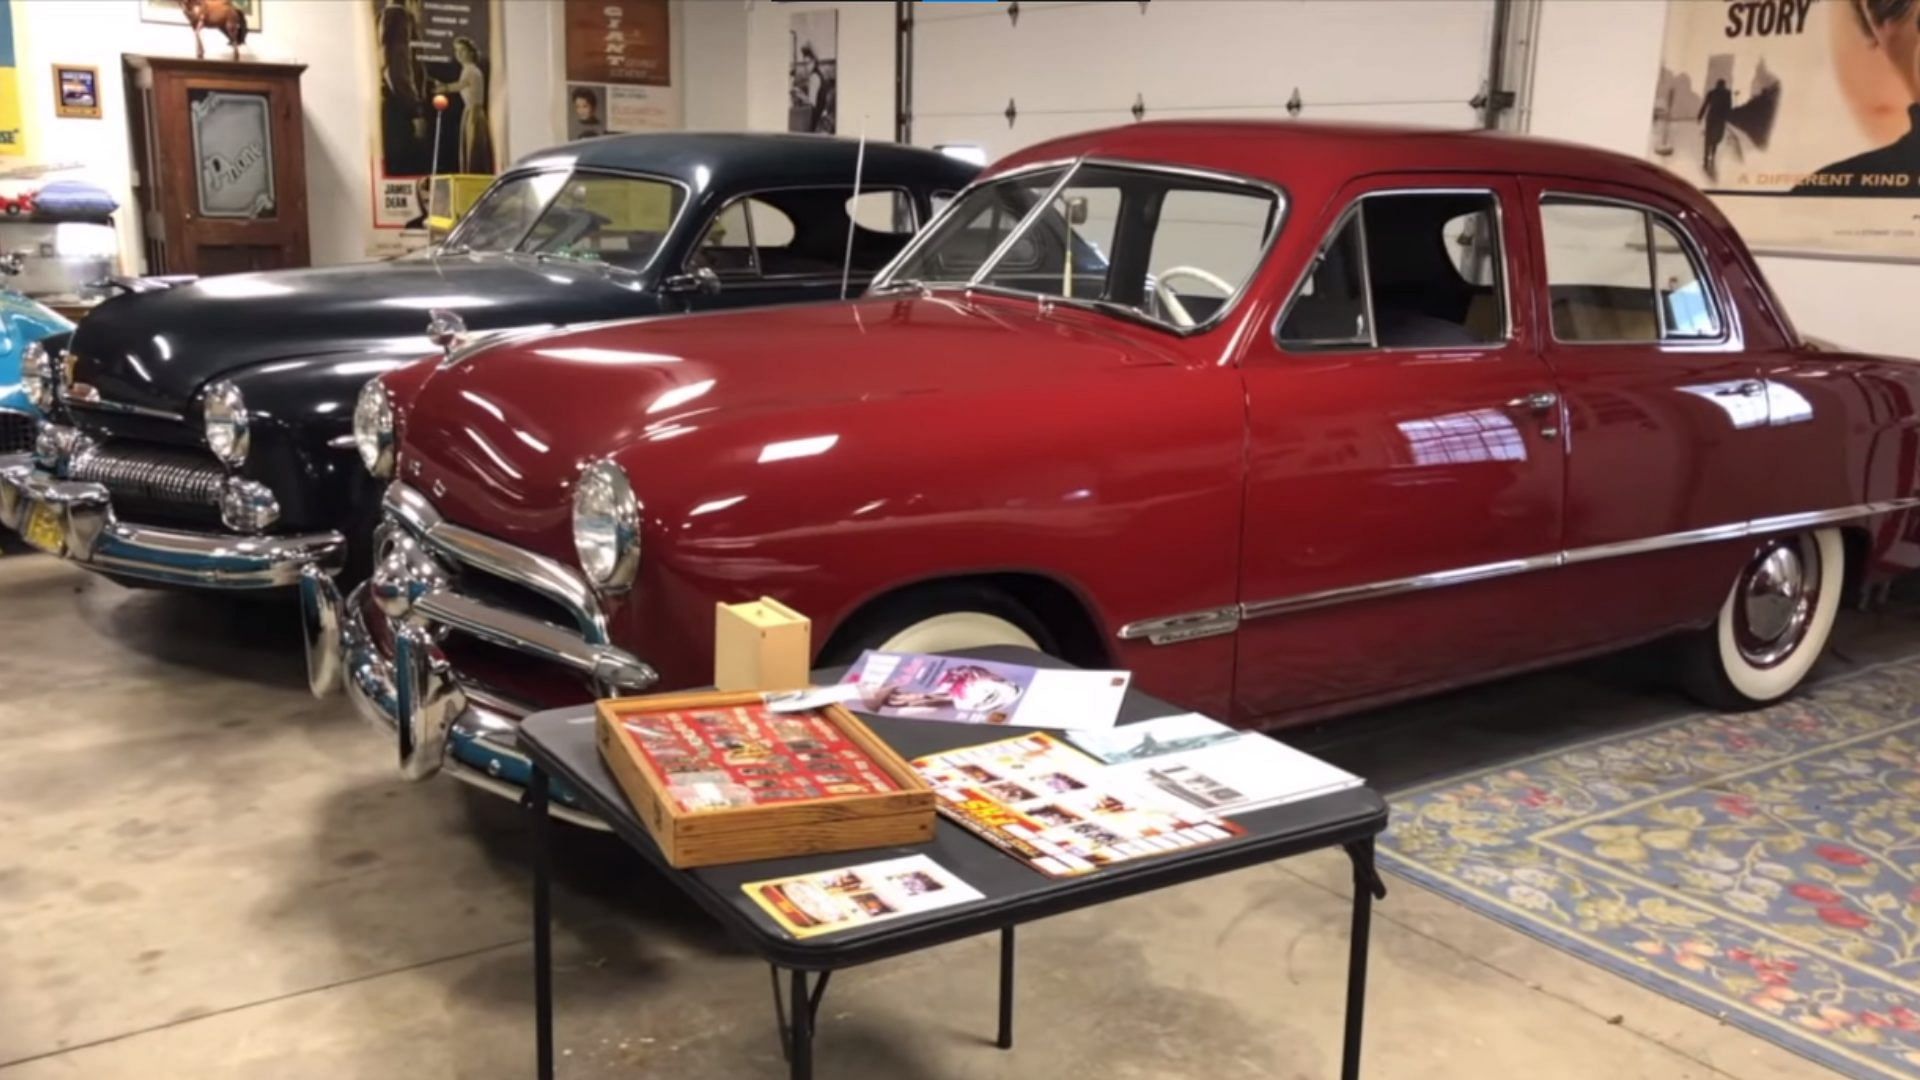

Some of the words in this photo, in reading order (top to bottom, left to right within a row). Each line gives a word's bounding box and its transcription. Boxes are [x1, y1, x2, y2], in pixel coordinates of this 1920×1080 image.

[1725, 0, 1811, 38] STORY
[1738, 173, 1749, 186] A
[1756, 173, 1855, 187] DIFFERENT
[1861, 173, 1910, 187] KIND
[384, 183, 413, 196] JAMES
[384, 196, 409, 209] DEAN
